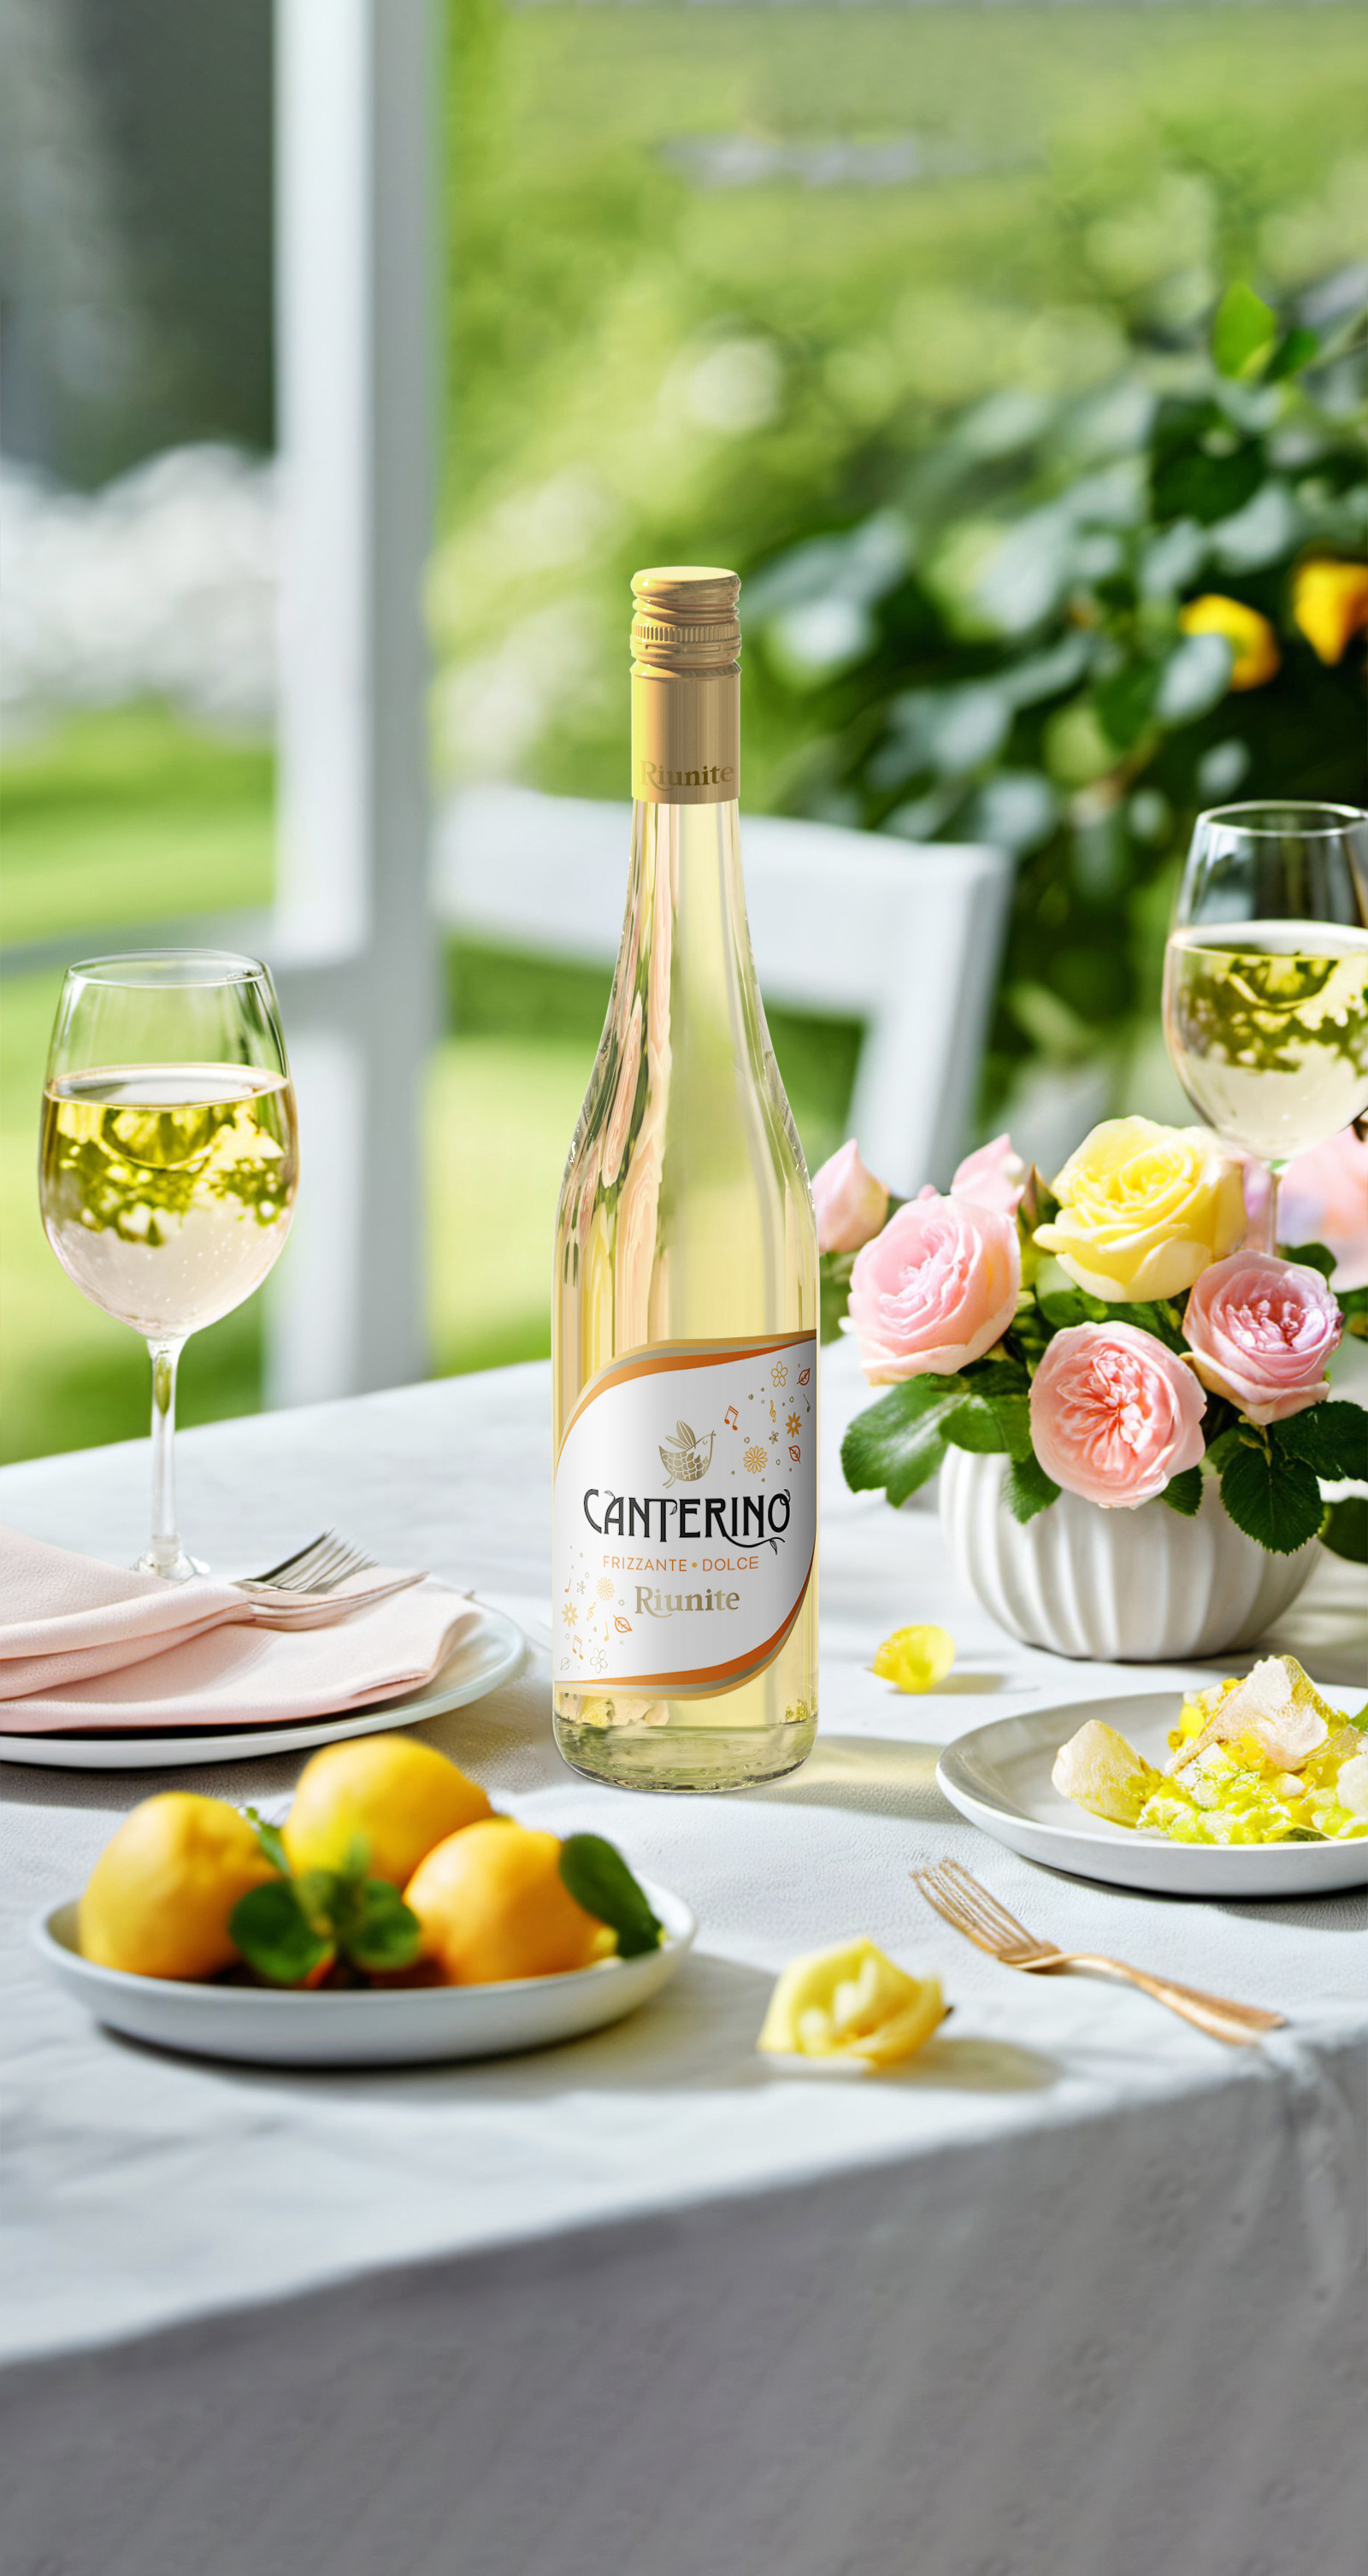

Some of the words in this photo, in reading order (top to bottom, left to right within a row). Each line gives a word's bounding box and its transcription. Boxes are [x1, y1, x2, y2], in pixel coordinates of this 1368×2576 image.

[640, 760, 734, 792] Riunite
[583, 1488, 791, 1550] CANTERINO
[603, 1555, 687, 1572] FRIZZANTE
[702, 1555, 759, 1572] DOLCE
[634, 1585, 740, 1618] Riunite
